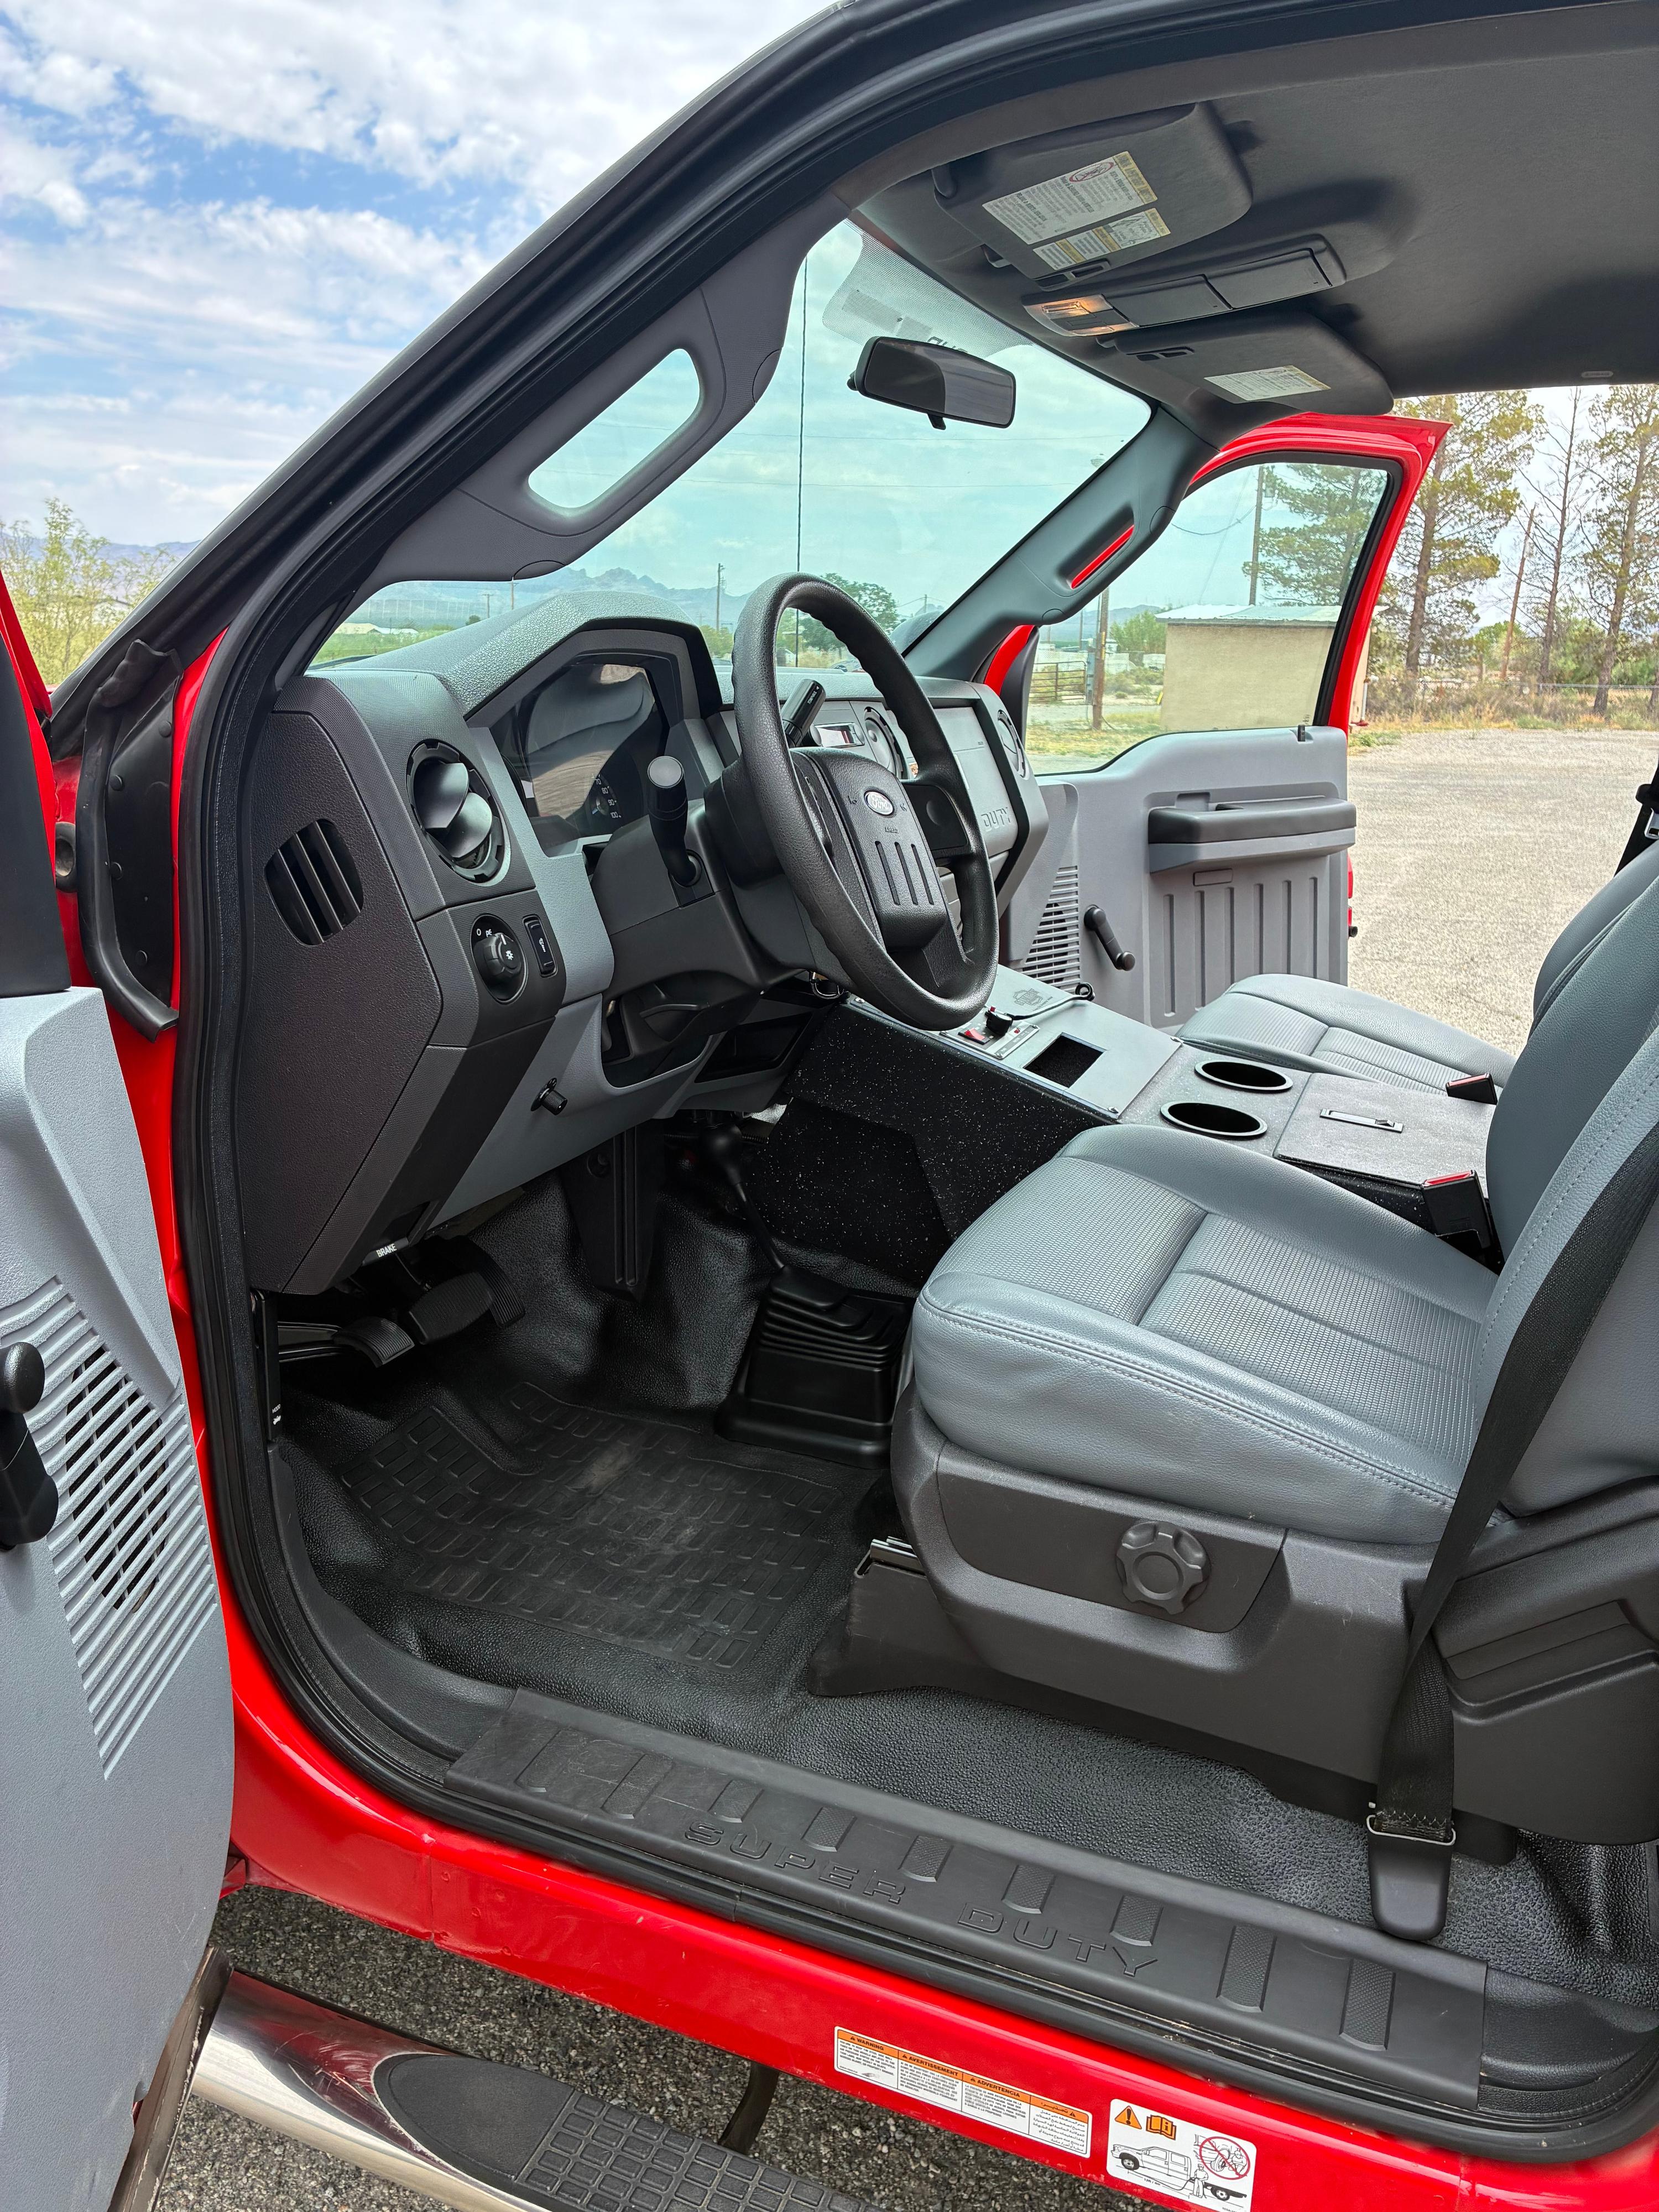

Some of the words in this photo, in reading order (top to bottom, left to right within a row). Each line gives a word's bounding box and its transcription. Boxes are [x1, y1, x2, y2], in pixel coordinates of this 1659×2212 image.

[980, 807, 1011, 832] DUTY
[376, 1243, 397, 1258] BRAKE
[684, 1820, 906, 1905] SUPER
[957, 1902, 1158, 1978] DUTY
[857, 2038, 884, 2051] WARNING
[909, 2057, 958, 2076] AVERTISSEMENT
[977, 2079, 1020, 2098] ADVERTENCIA
